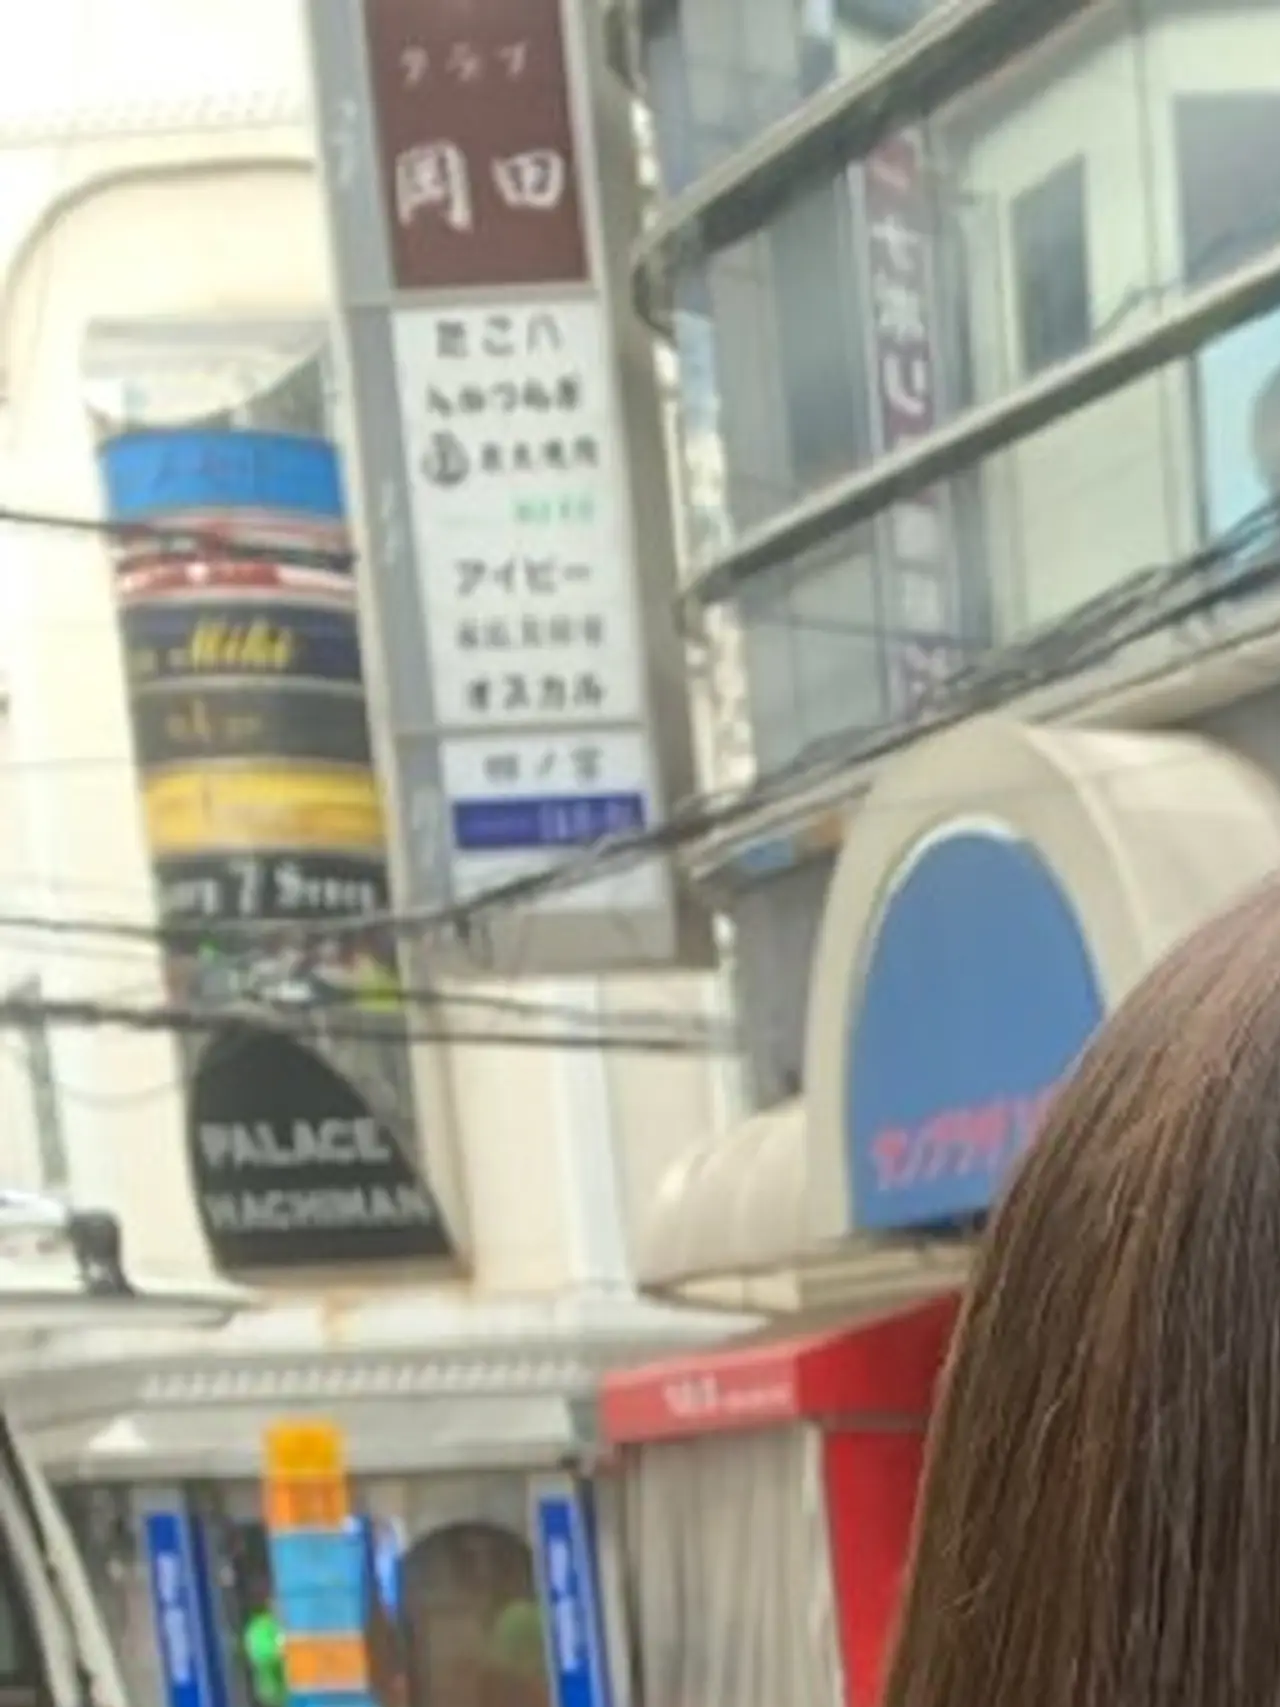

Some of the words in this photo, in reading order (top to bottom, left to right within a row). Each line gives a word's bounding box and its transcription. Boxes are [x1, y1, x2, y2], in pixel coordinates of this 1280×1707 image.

[395, 140, 566, 232] 岡田
[454, 557, 592, 597] アイビー
[466, 672, 606, 712] オスカル
[200, 1116, 391, 1171] PALACE
